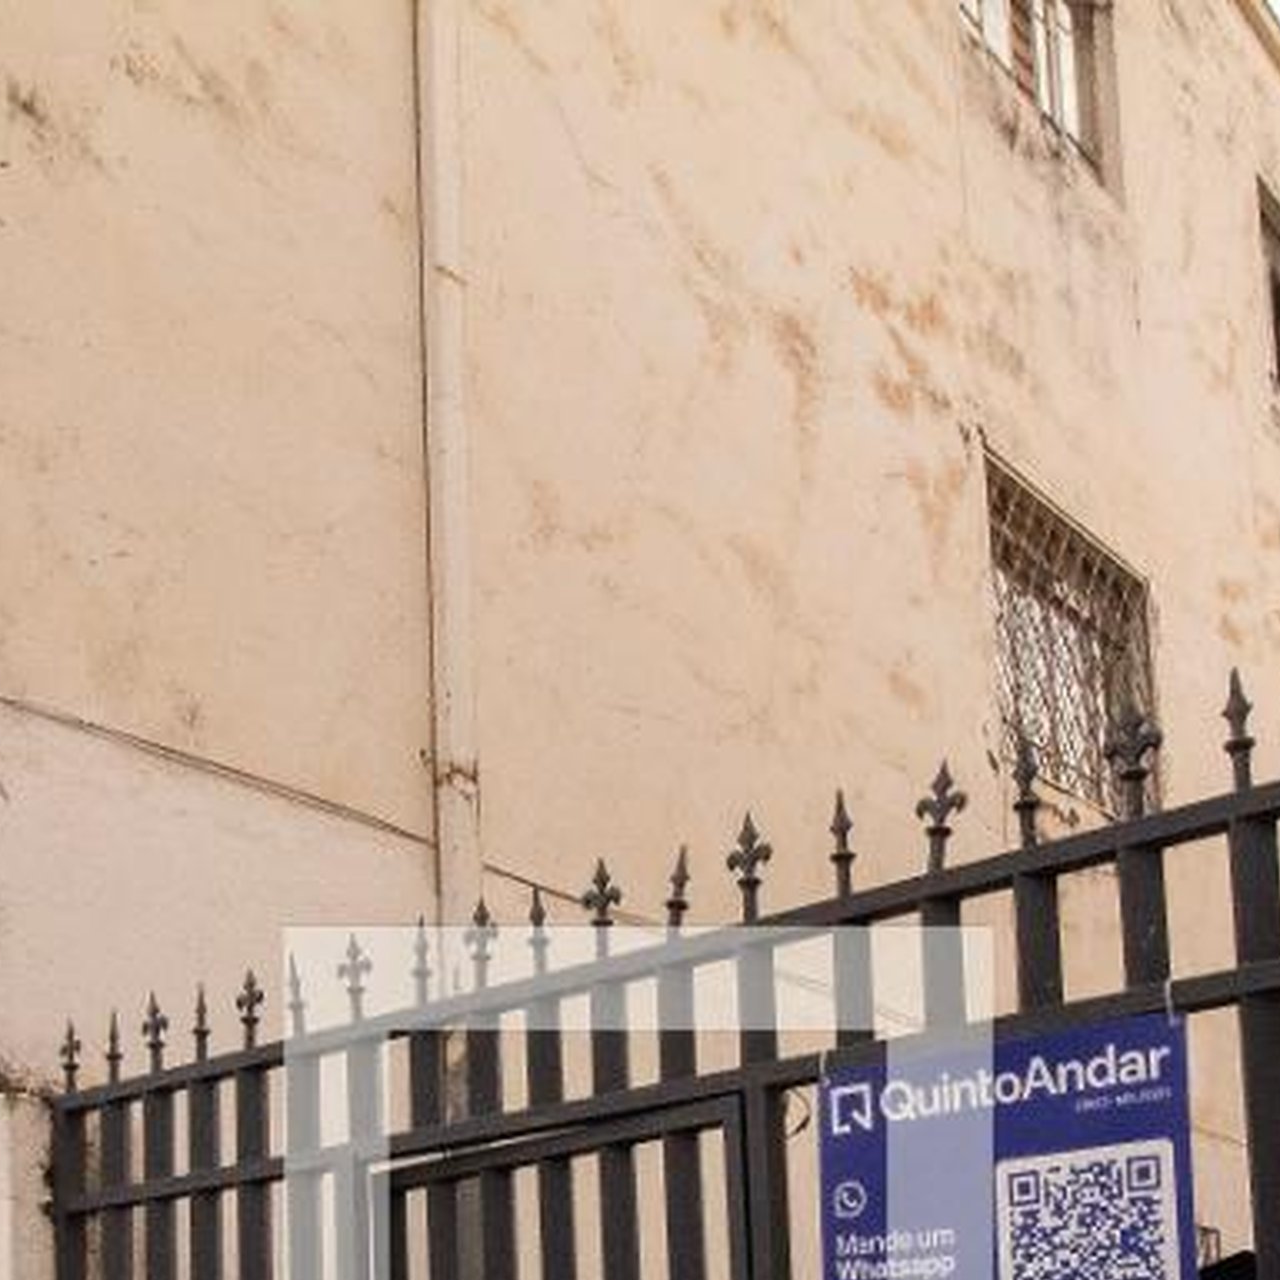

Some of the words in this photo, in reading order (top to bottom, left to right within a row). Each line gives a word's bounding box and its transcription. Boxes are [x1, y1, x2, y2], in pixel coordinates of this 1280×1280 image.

[879, 1043, 1172, 1121] QuintoAndar
[836, 1229, 913, 1256] Mande
[917, 1228, 955, 1248] um
